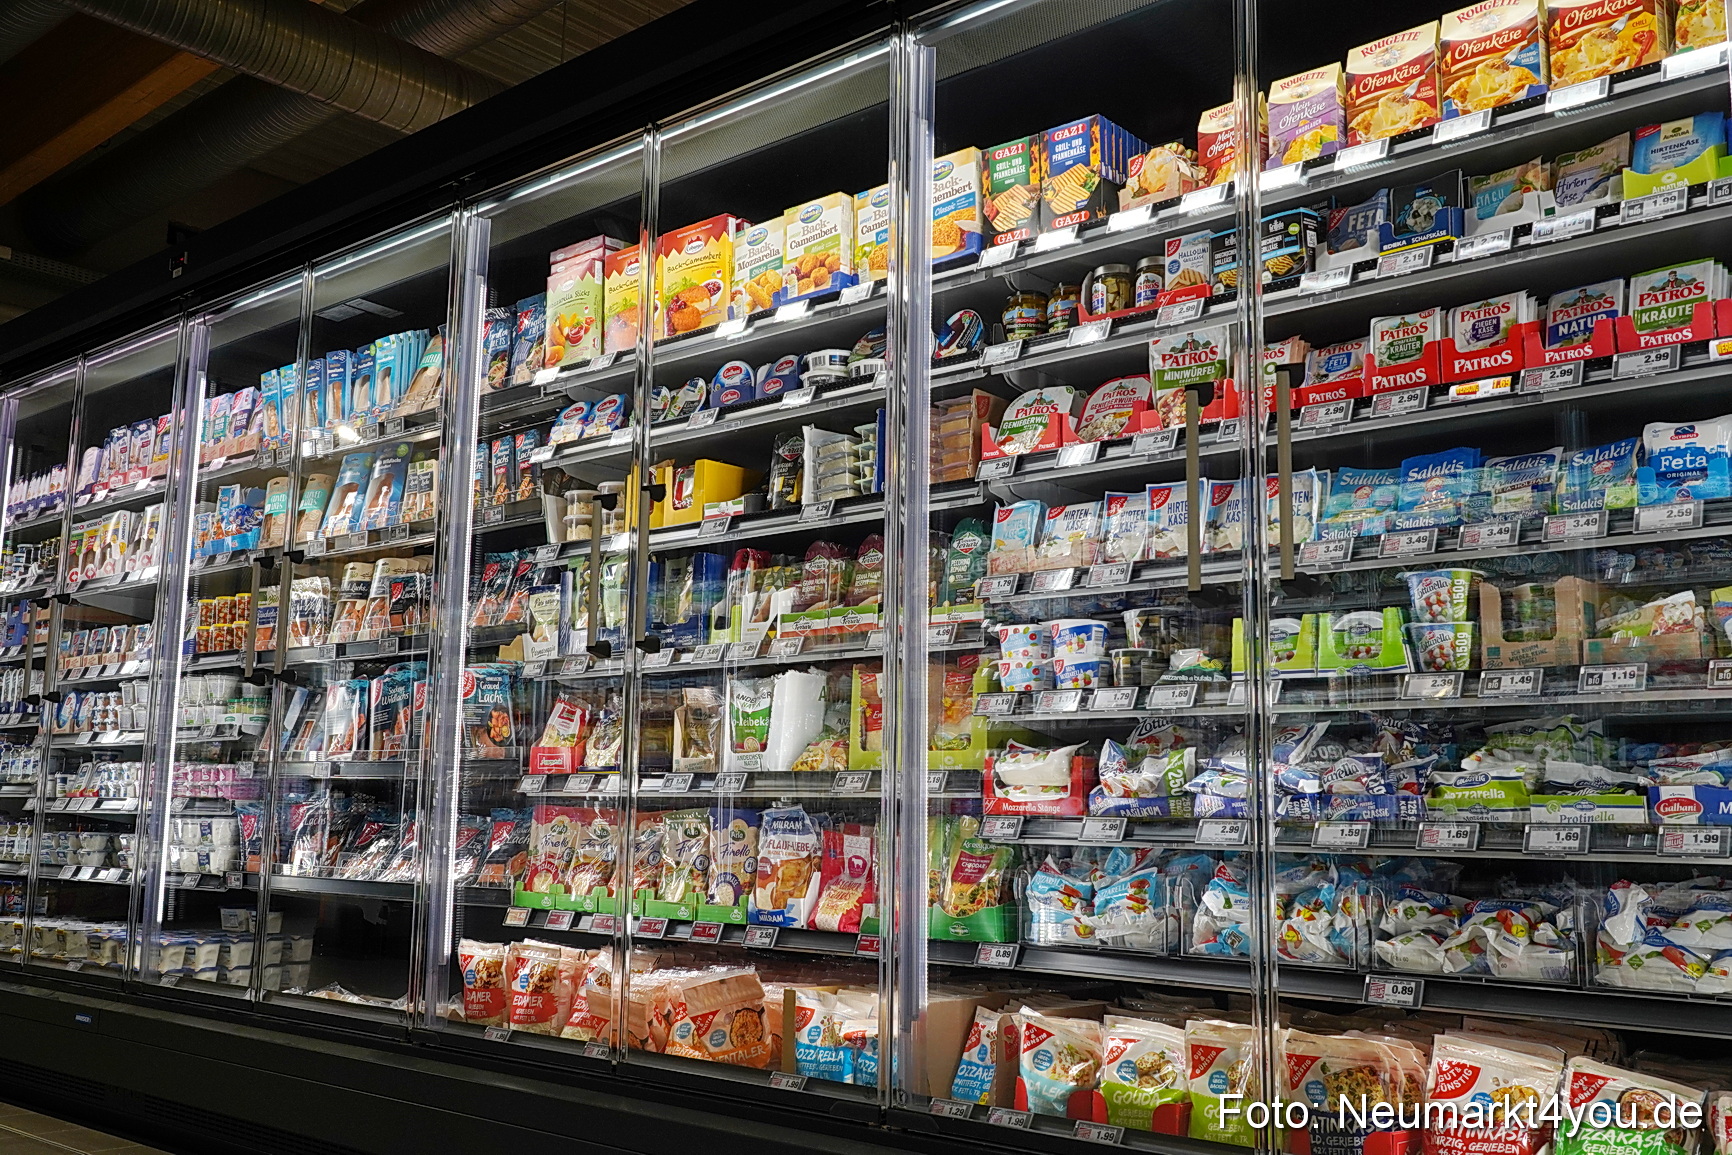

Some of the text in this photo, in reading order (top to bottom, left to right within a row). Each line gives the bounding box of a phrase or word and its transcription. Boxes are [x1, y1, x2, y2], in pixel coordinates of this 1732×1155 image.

[1632, 19, 1647, 28] CHILI
[1360, 30, 1421, 58] ROUGETTE
[1455, 29, 1521, 60] Ofenkäse
[1280, 71, 1328, 91] ROUGETTE
[1359, 63, 1421, 94] Ofenkäse
[1289, 101, 1310, 116] Mein
[1279, 101, 1326, 129] Ofenkäse
[1294, 118, 1322, 136] KNOBLAUCH
[1662, 129, 1690, 140] ALNATURA
[1652, 178, 1690, 194] ALNATURA
[1652, 196, 1676, 207] 1.99
[934, 204, 955, 216] Classic
[1348, 208, 1384, 232] FETA
[801, 220, 830, 236] Back-
[789, 224, 838, 250] Camembert
[1411, 230, 1447, 243] SCHAFSKÄSE
[748, 242, 774, 259] Back-
[1178, 247, 1209, 260] HALLOUMI
[737, 248, 780, 272] Mozzarella
[1402, 252, 1424, 264] 2.19
[1638, 281, 1706, 307] PATROS
[1178, 304, 1196, 314] 2.99
[1460, 302, 1510, 323] PATROS
[1552, 296, 1616, 324] PATROS
[1642, 304, 1694, 324] KRÄUTE
[1474, 318, 1498, 329] ZIEGEN
[1478, 325, 1494, 334] KÄSE
[1380, 322, 1428, 342] PATROS
[1640, 328, 1693, 348] PATROS
[1318, 342, 1362, 358] PATROS
[1390, 340, 1421, 354] KRÄUTER
[1161, 346, 1219, 368] PATROS
[1545, 345, 1593, 364] PATROS
[1644, 352, 1669, 364] 2.99
[1328, 356, 1348, 368] FETA
[1454, 350, 1513, 374] PATROS
[724, 366, 742, 378] Galbani
[1164, 366, 1216, 382] MINIWÜRFEL
[1550, 368, 1573, 378] 2.99
[1372, 368, 1426, 391] PATROS
[764, 380, 782, 392] Galbani
[720, 390, 740, 402] Galbani
[1102, 387, 1137, 401] PATROS
[1308, 388, 1346, 404] PATROS
[1398, 394, 1419, 404] 2.99
[1014, 404, 1059, 418] PATROS
[1325, 406, 1344, 416] 2.99
[1153, 435, 1170, 444] 2.99
[1572, 441, 1632, 466] Salakis
[995, 462, 1010, 470] 2.99
[1496, 456, 1547, 473] Salakis
[1660, 449, 1708, 471] Feta
[1408, 460, 1464, 482] Salakis
[1666, 470, 1700, 478] ORIGINAL
[1340, 472, 1395, 486] Salakis
[1562, 498, 1603, 512] Salakis
[1063, 508, 1092, 521] HIRTEN-
[1666, 508, 1692, 518] 2.59
[1396, 514, 1434, 530] Salakis
[1573, 518, 1598, 528] 3.49
[1322, 527, 1358, 540] Salakis
[1487, 526, 1510, 536] 3.49
[1406, 536, 1428, 544] 3.49
[1324, 544, 1344, 552] 3.49
[1109, 568, 1125, 576] 1.79
[996, 580, 1011, 588] 1.79
[1509, 676, 1532, 686] 1.49
[1610, 670, 1636, 681] 1.19
[1430, 678, 1453, 688] 2.39
[478, 688, 502, 704] Lachs
[1114, 692, 1130, 701] 1.79
[1172, 690, 1188, 698] 1.69
[995, 698, 1010, 706] 1.19
[1002, 802, 1061, 814] Mozzarella Stange
[1660, 802, 1697, 813] Galbani
[1560, 811, 1615, 824] Protinella
[772, 820, 802, 830] MILRAM
[1220, 826, 1240, 834] 2.99
[1340, 828, 1360, 837] 1.59
[1447, 830, 1468, 839] 1.69
[1555, 832, 1578, 841] 1.69
[1693, 834, 1719, 844] 1.99
[758, 914, 784, 922] MILRAM
[996, 950, 1011, 958] 0.89
[1392, 985, 1414, 996] 0.89
[1196, 1050, 1217, 1074] GÜNSTIG
[785, 1080, 799, 1088] 1.99
[1574, 1079, 1605, 1104] GÜNSTIG
[1113, 1090, 1160, 1106] GOUDA
[948, 1107, 965, 1116] 1.29
[1007, 1116, 1025, 1126] 1.99
[1095, 1130, 1114, 1142] 1.99
[1326, 1136, 1366, 1146] GERIEBE
